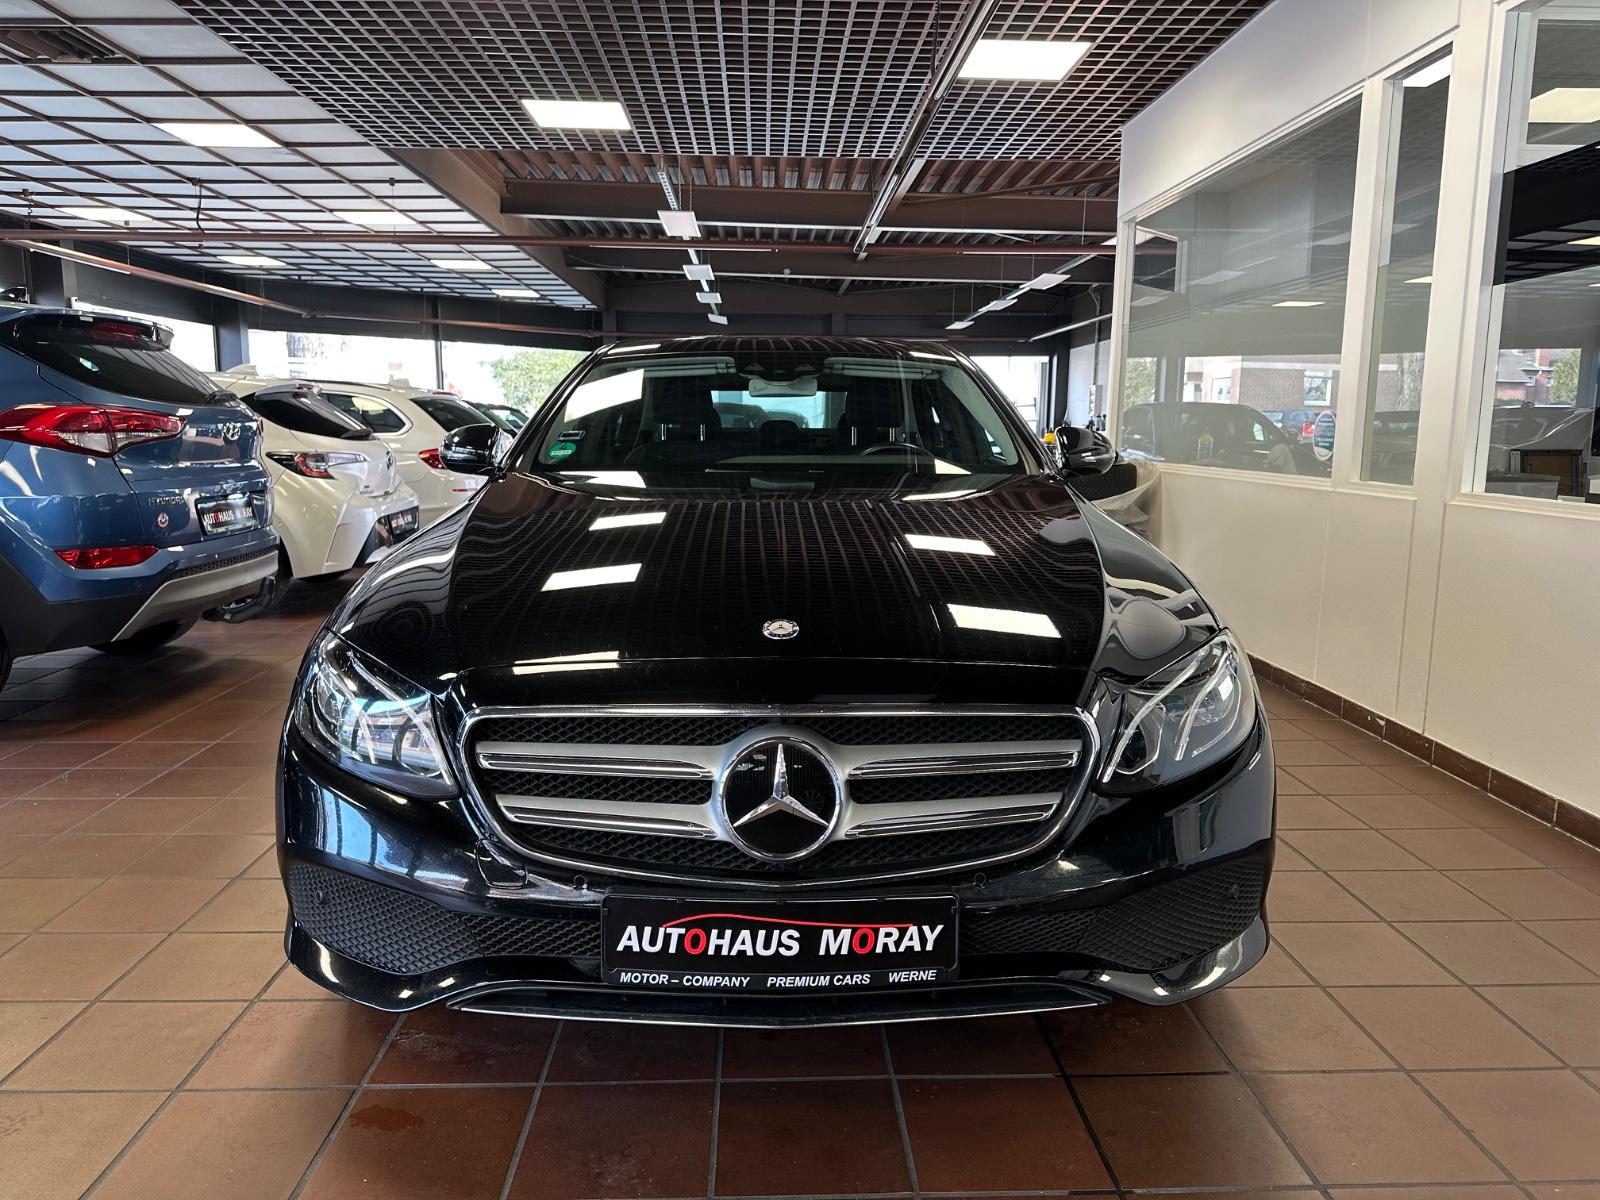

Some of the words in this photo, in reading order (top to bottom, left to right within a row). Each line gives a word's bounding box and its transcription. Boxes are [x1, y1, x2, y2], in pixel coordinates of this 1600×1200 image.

[204, 510, 235, 525] AUTOHAUS
[616, 926, 801, 957] AUTOHAUS
[818, 924, 945, 956] MORAY
[620, 972, 669, 985] MOTOR
[683, 975, 751, 988] COMPANY
[767, 975, 831, 988] PREMIUM
[833, 974, 872, 986] CARS
[888, 970, 937, 983] WERNE
